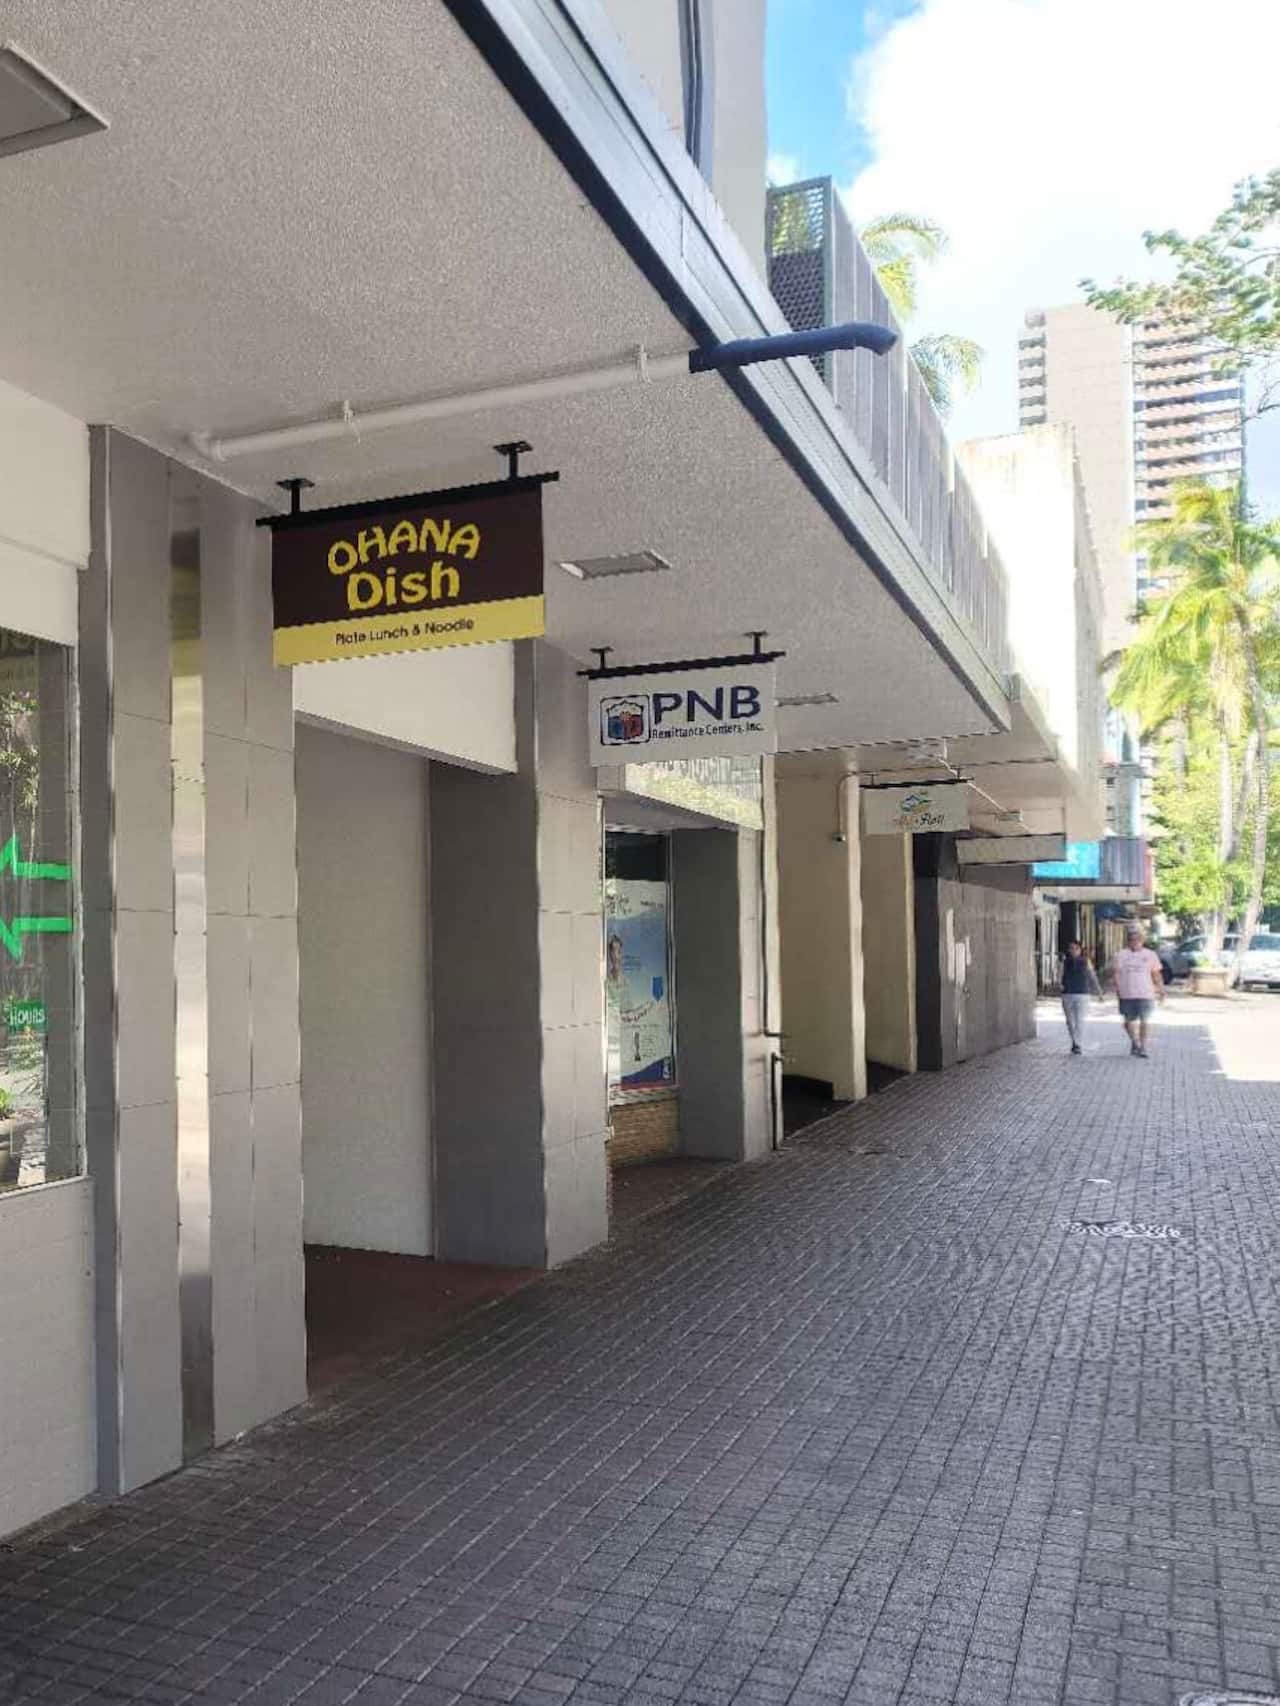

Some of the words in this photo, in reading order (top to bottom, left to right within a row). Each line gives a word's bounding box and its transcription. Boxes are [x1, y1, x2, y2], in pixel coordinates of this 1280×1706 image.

[327, 518, 481, 576] OHANA
[347, 560, 460, 611] Dish
[335, 632, 366, 645] Plate
[370, 626, 408, 641] Lunch
[412, 626, 421, 636] &
[425, 618, 475, 635] Noodle
[652, 685, 761, 725] PNB
[652, 727, 705, 739] Remittance
[9, 1007, 46, 1025] HOURS
